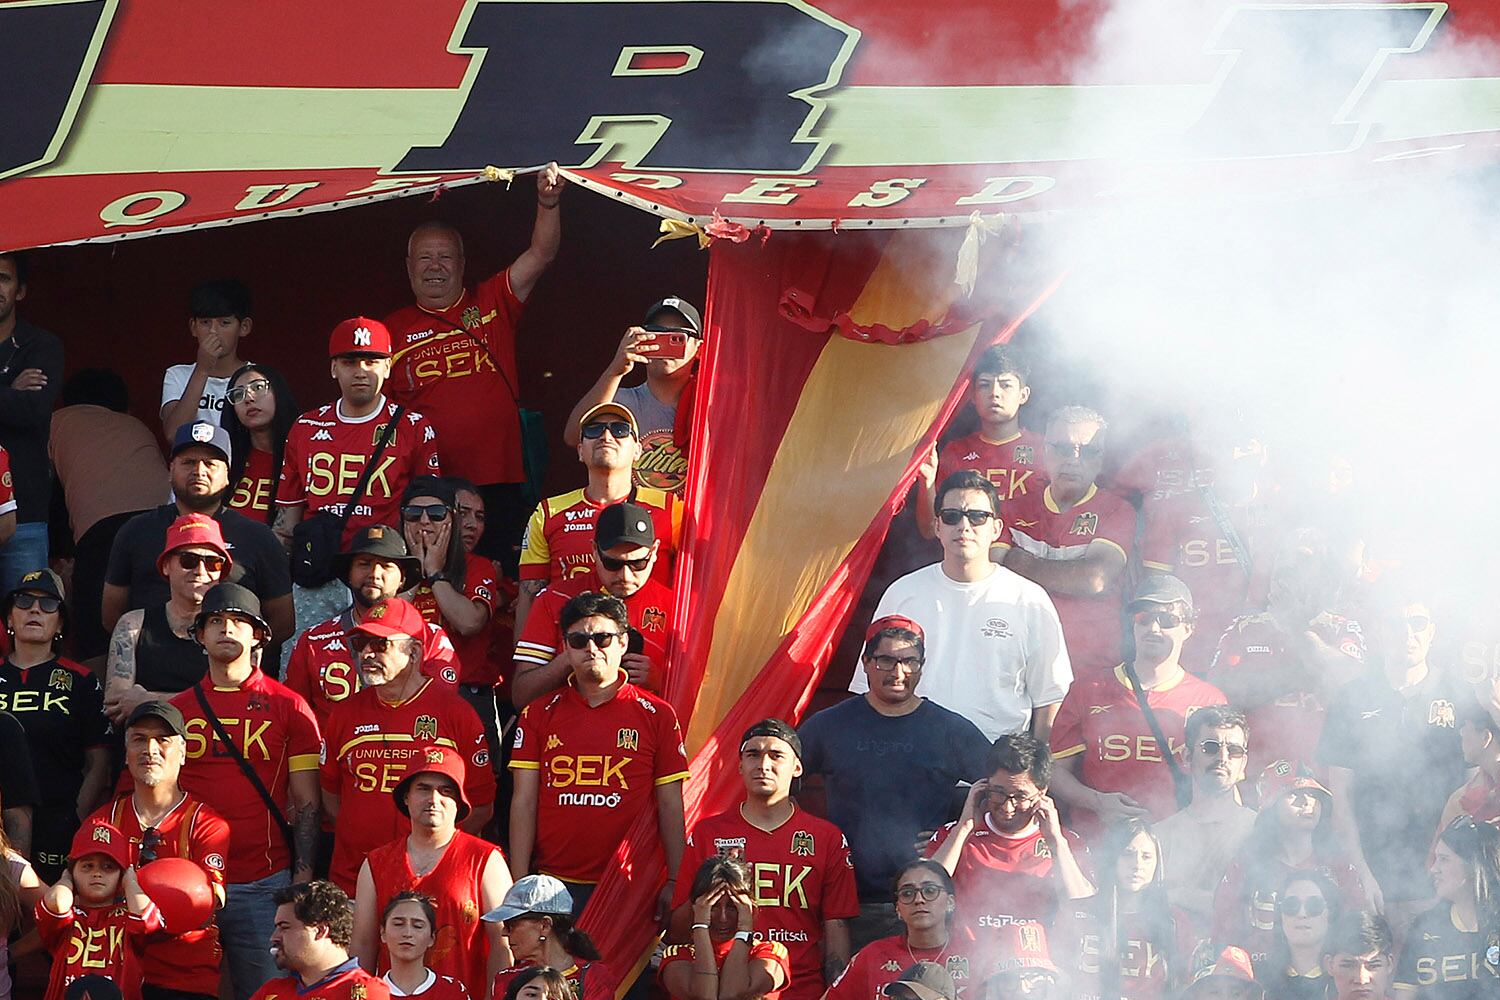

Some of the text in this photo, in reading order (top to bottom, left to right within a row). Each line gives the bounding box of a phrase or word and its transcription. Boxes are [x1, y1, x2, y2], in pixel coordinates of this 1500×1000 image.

[415, 352, 497, 377] SEK
[310, 453, 395, 498] SEK
[230, 478, 273, 510] SE
[1182, 539, 1242, 567] SE
[358, 763, 405, 791] SE
[550, 755, 632, 790] SEK
[753, 863, 812, 909] EK
[769, 927, 808, 943] Fritsch
